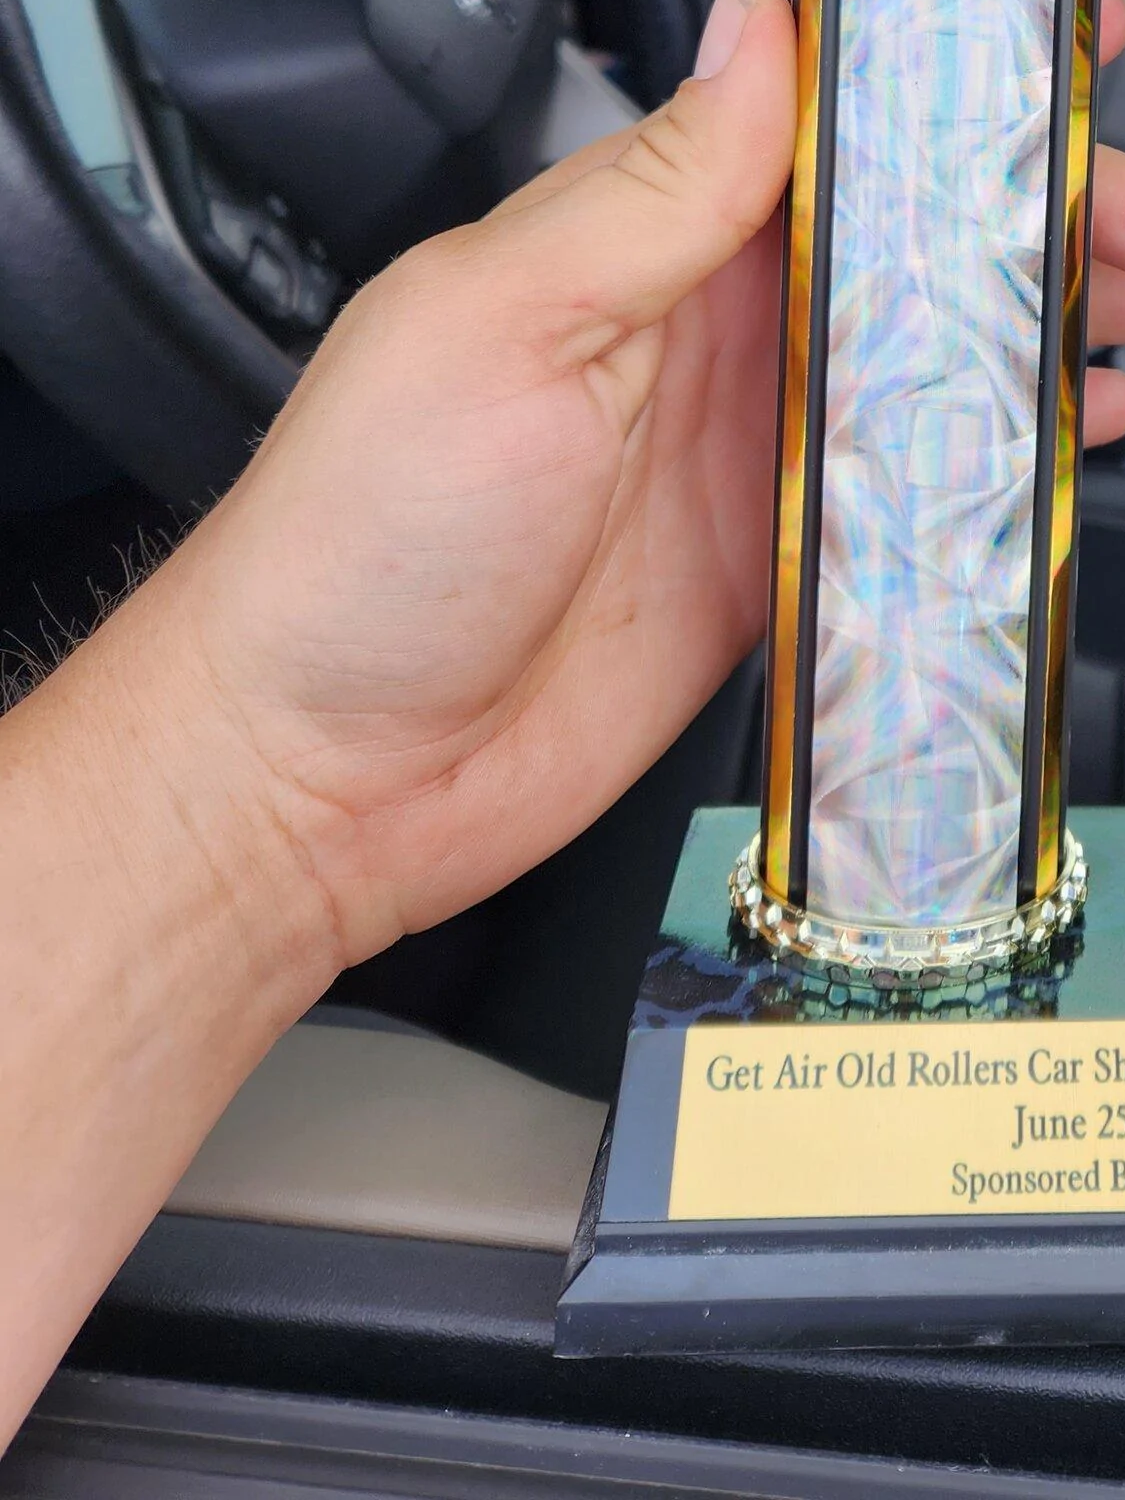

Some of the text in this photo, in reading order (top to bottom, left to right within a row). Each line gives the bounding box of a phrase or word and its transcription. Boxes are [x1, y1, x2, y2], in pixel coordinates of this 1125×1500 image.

[706, 1055, 763, 1092] Get
[773, 1054, 828, 1089] Air
[836, 1051, 896, 1089] Old
[907, 1050, 1019, 1087] Rollers
[1027, 1048, 1084, 1085] Car
[1011, 1104, 1087, 1150] June
[951, 1159, 1101, 1204] Sponsored
